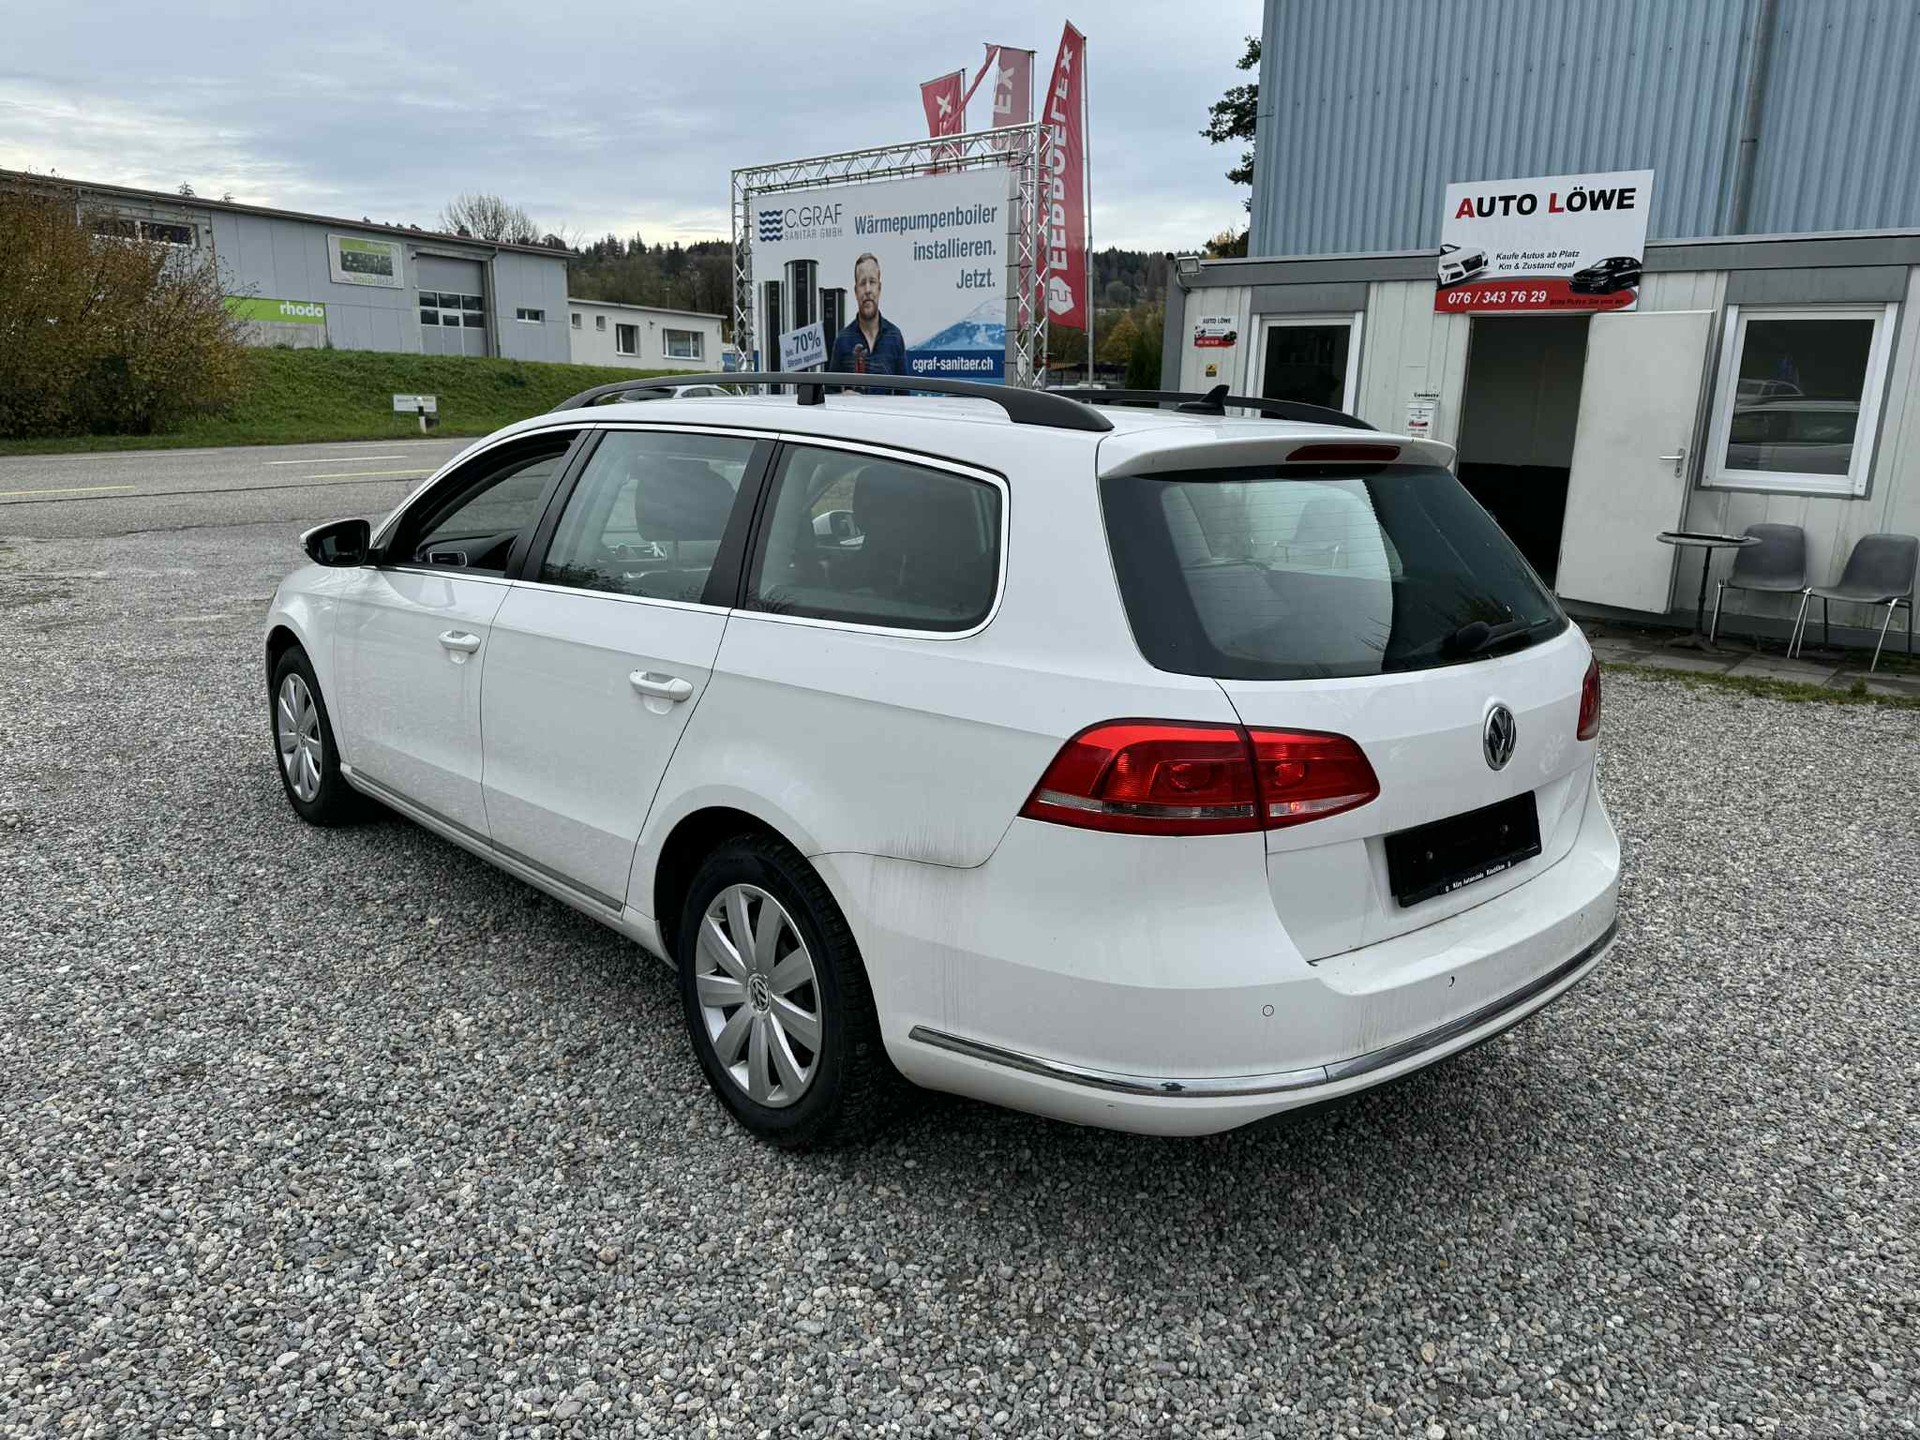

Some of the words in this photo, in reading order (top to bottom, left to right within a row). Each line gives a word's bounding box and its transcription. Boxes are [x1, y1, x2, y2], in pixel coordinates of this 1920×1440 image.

[1455, 193, 1538, 219] AUTO
[1548, 186, 1637, 214] LÖWE
[854, 203, 998, 235] Wärmepumpenboiler
[913, 239, 997, 261] installieren.
[1495, 252, 1519, 261] Kaufe
[1521, 251, 1545, 260] Autos
[1547, 251, 1557, 259] ab
[1558, 250, 1580, 259] Platz
[1498, 262, 1512, 270] Km
[1513, 262, 1520, 270] &
[1522, 261, 1555, 270] Zustand
[1557, 261, 1576, 271] egal
[956, 268, 996, 289] Jetzt.
[1448, 291, 1472, 304] 076
[1473, 291, 1481, 304] /
[1482, 291, 1506, 304] 343
[1510, 291, 1527, 303] 76
[1530, 290, 1547, 303] 29
[279, 301, 324, 318] rhodo
[792, 328, 821, 354] 70%
[912, 355, 994, 373] cgraf-sanitaer.ch
